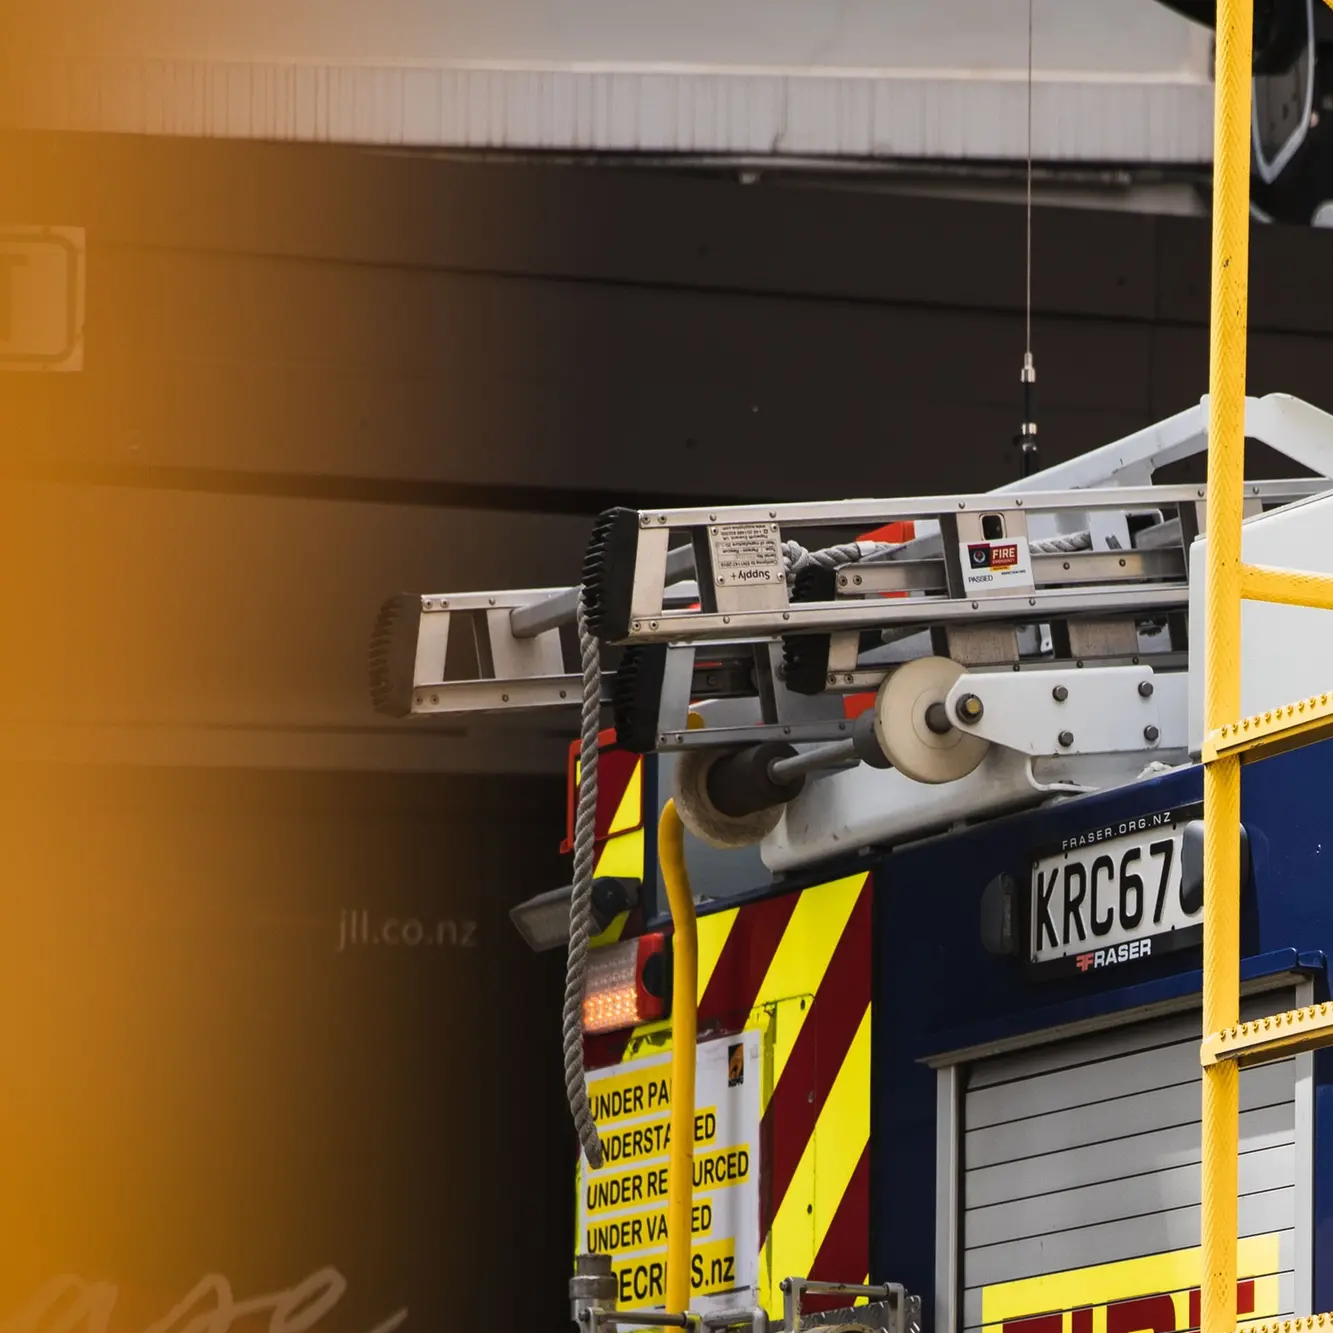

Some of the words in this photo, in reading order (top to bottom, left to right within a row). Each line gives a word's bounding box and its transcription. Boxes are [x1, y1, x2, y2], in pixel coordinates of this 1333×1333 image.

[992, 547, 1016, 560] FIRE
[968, 574, 994, 584] PASSED
[1062, 811, 1171, 850] FRASER.ORG.NZ
[334, 906, 478, 953] jll.co.nz
[1076, 938, 1152, 973] FRASER
[588, 1085, 644, 1122] UNDER
[648, 1079, 673, 1108] PA
[600, 1113, 716, 1164] NDERSTAED
[587, 1175, 643, 1210] UNDER
[647, 1151, 749, 1198] REURCED
[587, 1219, 643, 1254] UNDER
[646, 1205, 712, 1242] VAED
